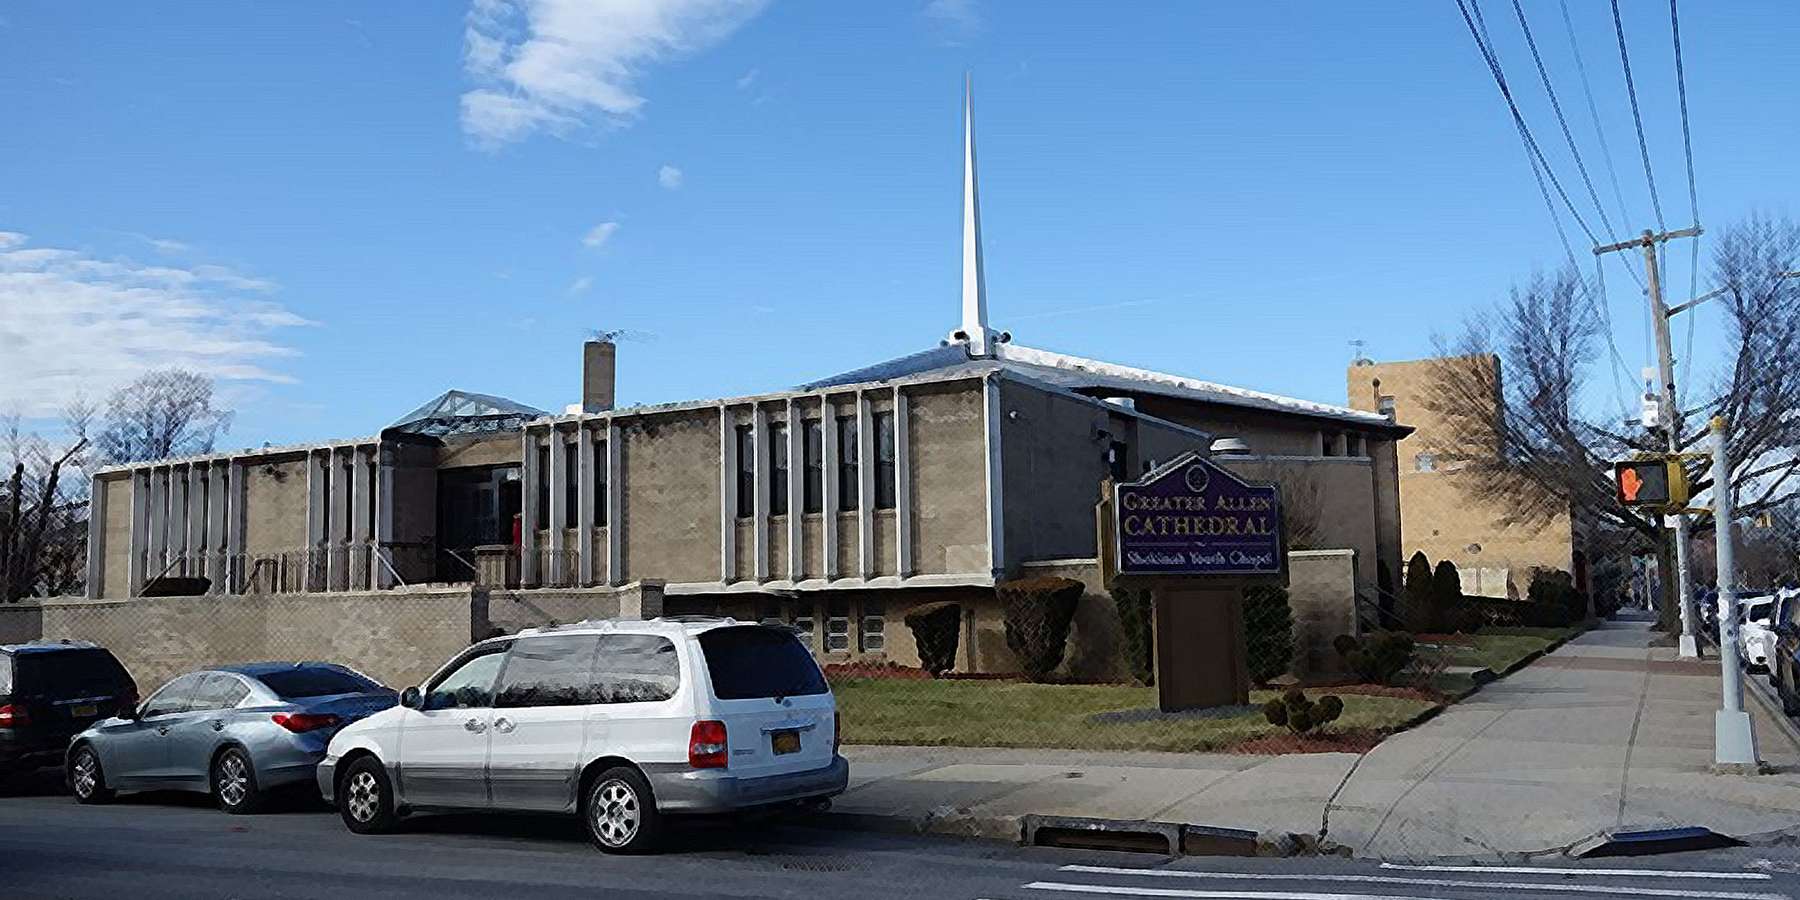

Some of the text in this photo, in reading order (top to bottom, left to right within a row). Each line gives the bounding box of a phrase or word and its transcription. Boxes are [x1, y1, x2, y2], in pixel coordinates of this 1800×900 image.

[1123, 492, 1271, 511] GREATER ALLEN
[1124, 515, 1273, 536] CATHEDRAL
